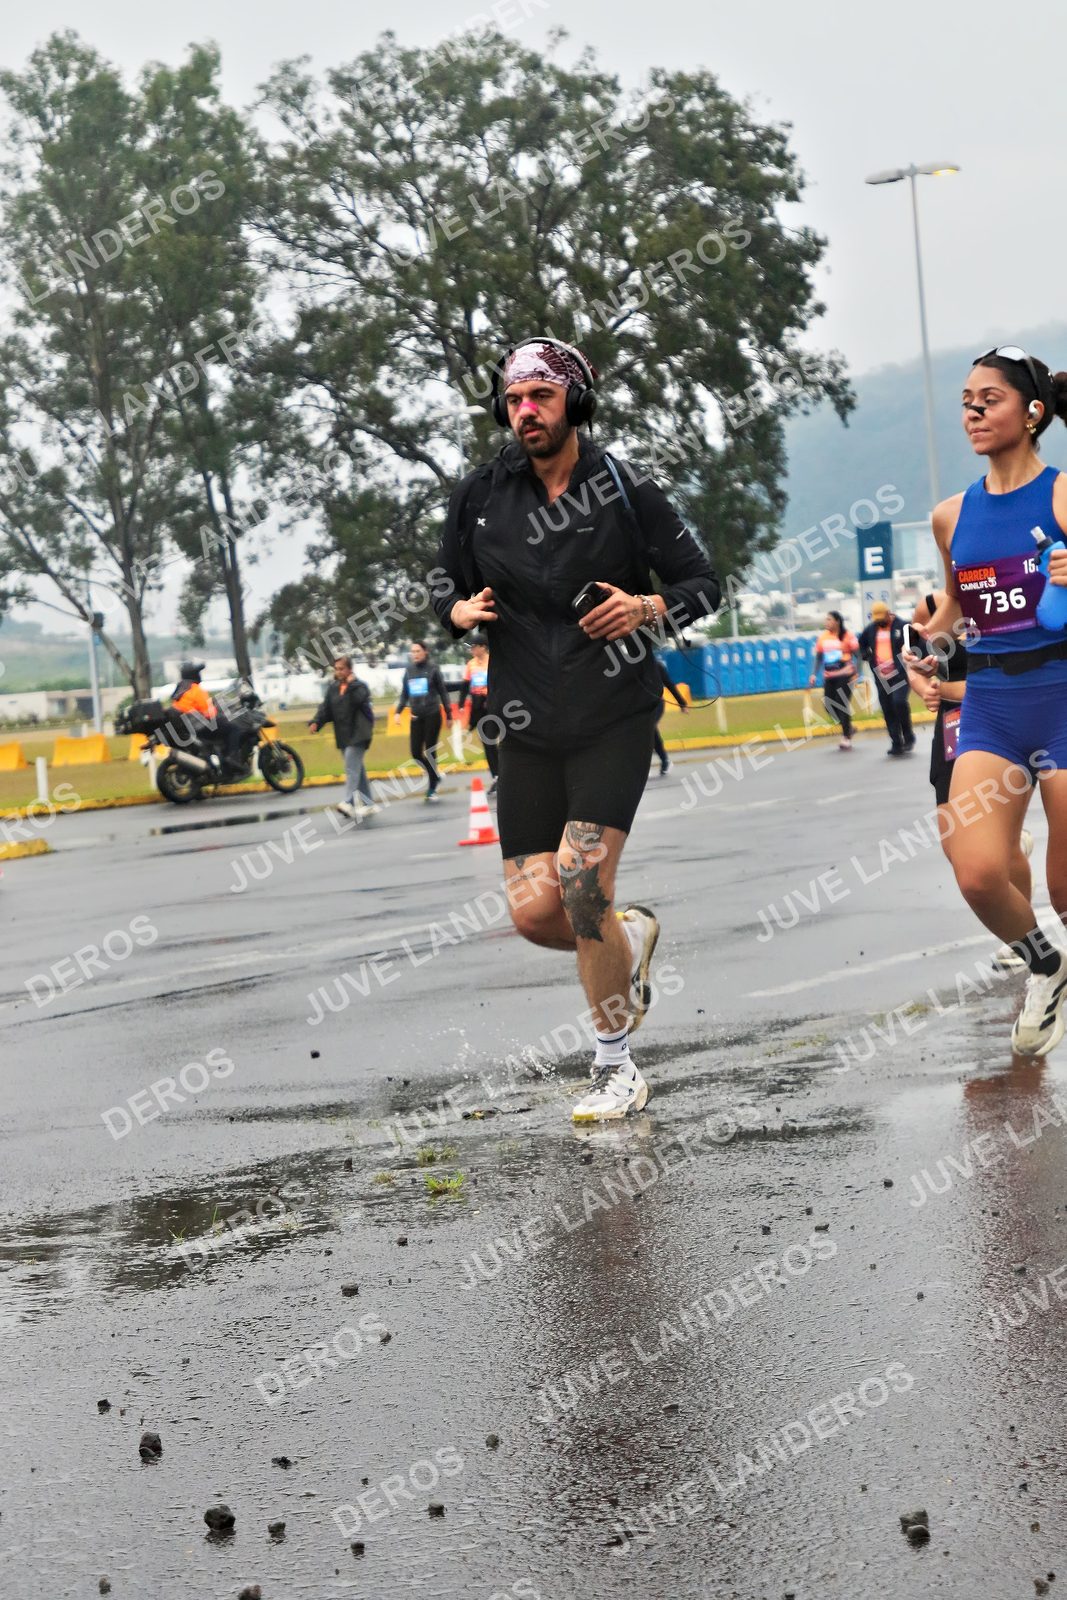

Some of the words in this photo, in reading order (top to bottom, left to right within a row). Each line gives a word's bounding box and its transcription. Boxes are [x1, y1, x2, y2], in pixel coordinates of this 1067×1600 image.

[864, 546, 885, 575] E
[958, 566, 996, 583] CARRERA
[960, 580, 989, 592] OMNILIFE
[979, 587, 1027, 615] 736
